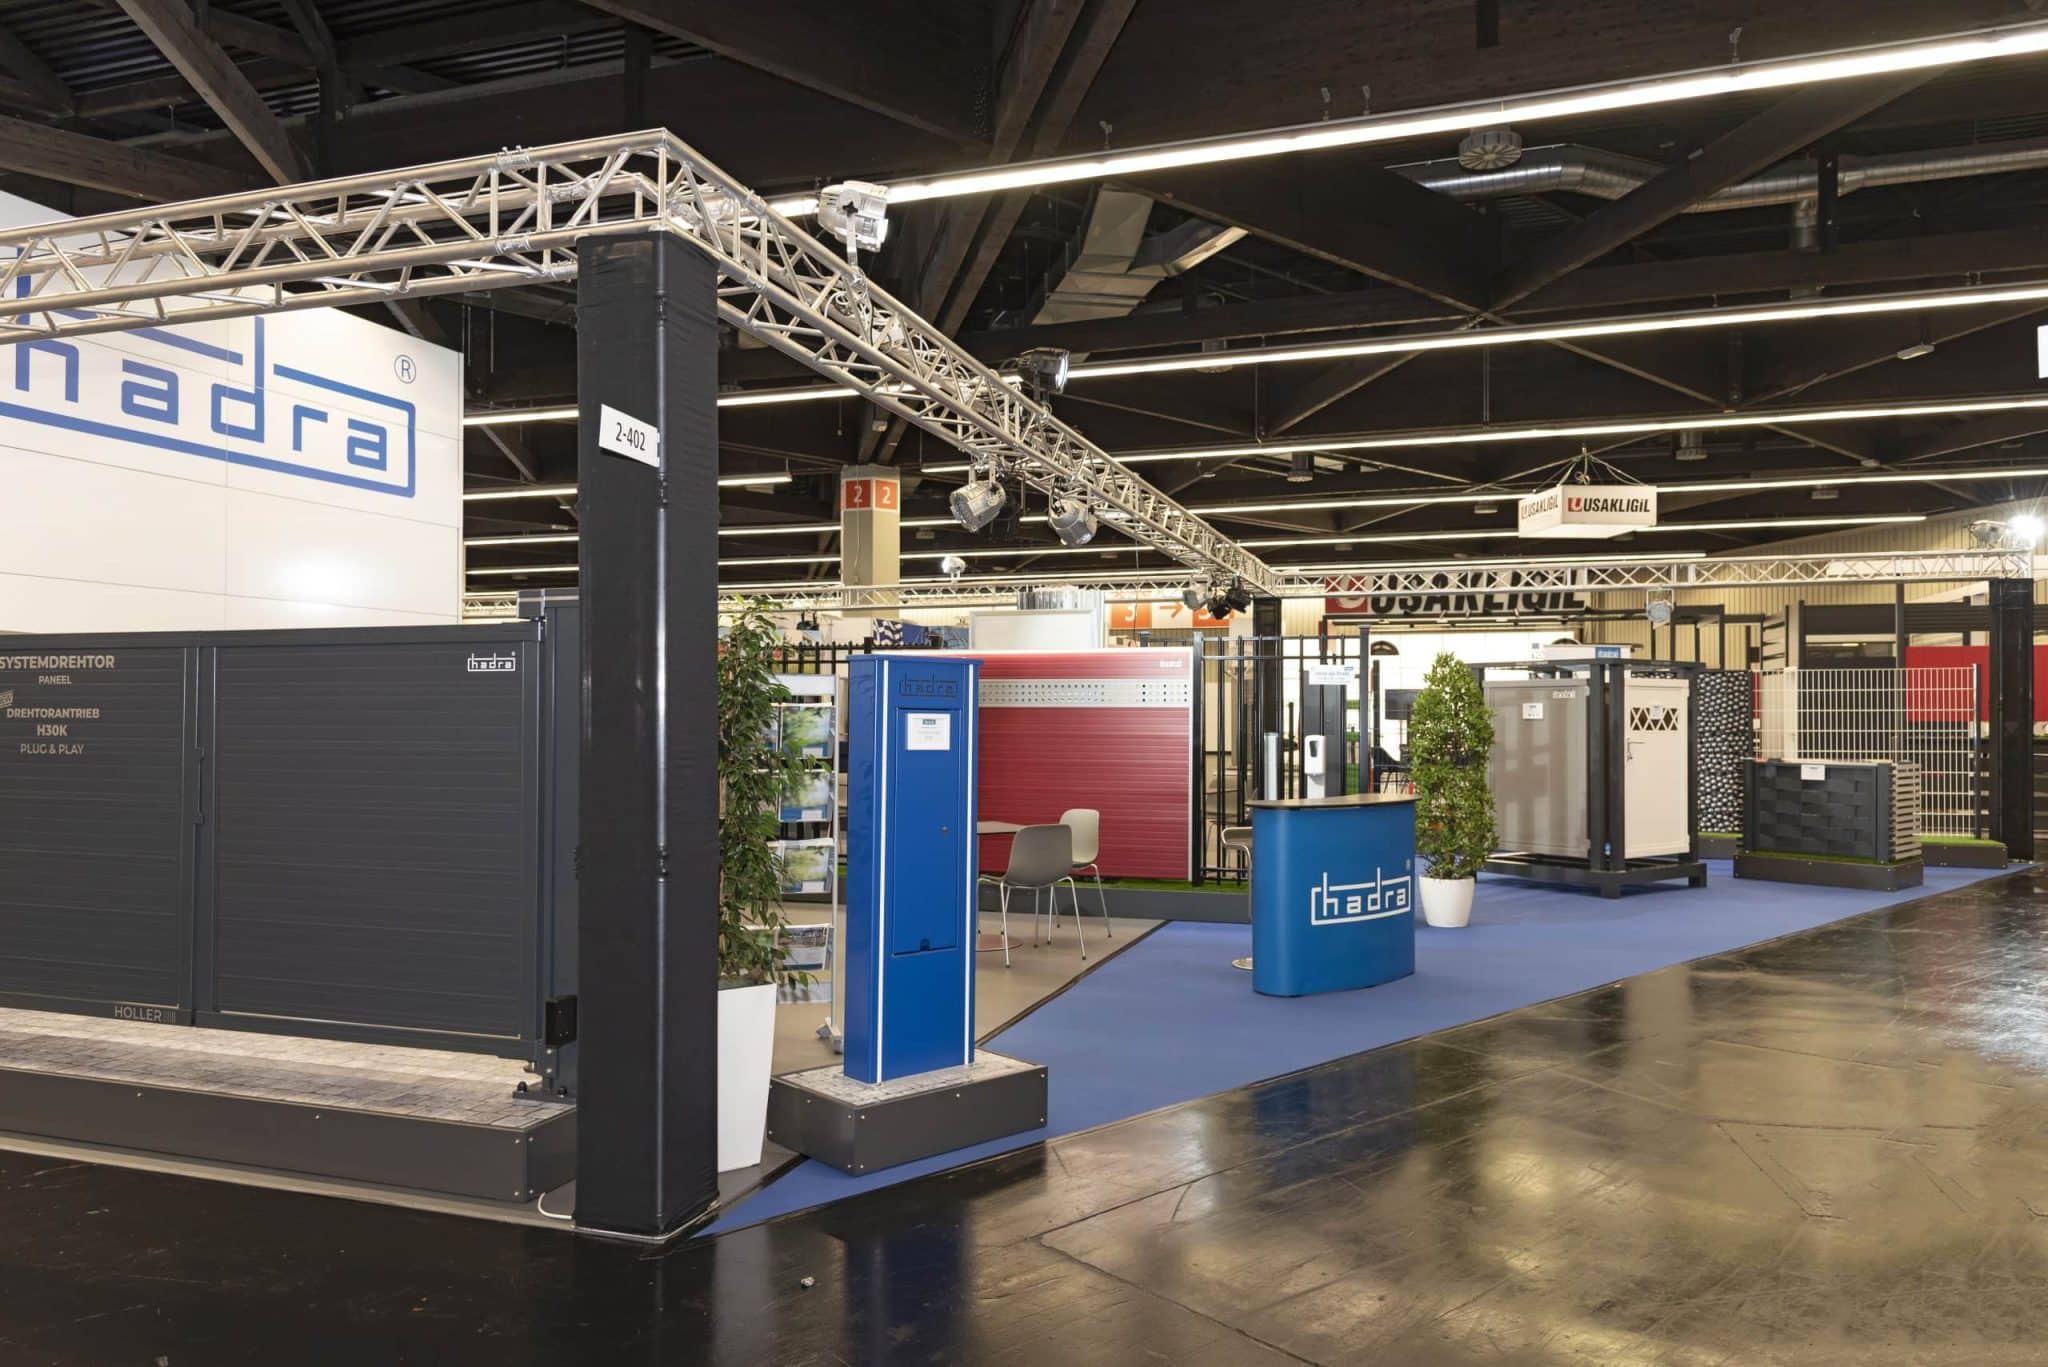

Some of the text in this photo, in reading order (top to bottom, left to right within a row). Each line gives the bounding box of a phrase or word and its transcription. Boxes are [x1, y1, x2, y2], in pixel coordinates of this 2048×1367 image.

[15, 247, 388, 472] hadra
[616, 422, 646, 451] 2-402
[853, 485, 863, 503] 2
[881, 486, 892, 504] 2
[0, 655, 115, 669] SYSTEMDREHTOR
[471, 652, 512, 669] hadra
[39, 675, 72, 685] PANEEL
[7, 708, 100, 719] DREHTORANTRIEB
[37, 724, 68, 737] H30K
[20, 743, 84, 755] PLUG & PLAY
[1323, 866, 1407, 918] hadra
[115, 1005, 162, 1021] HOLLER
